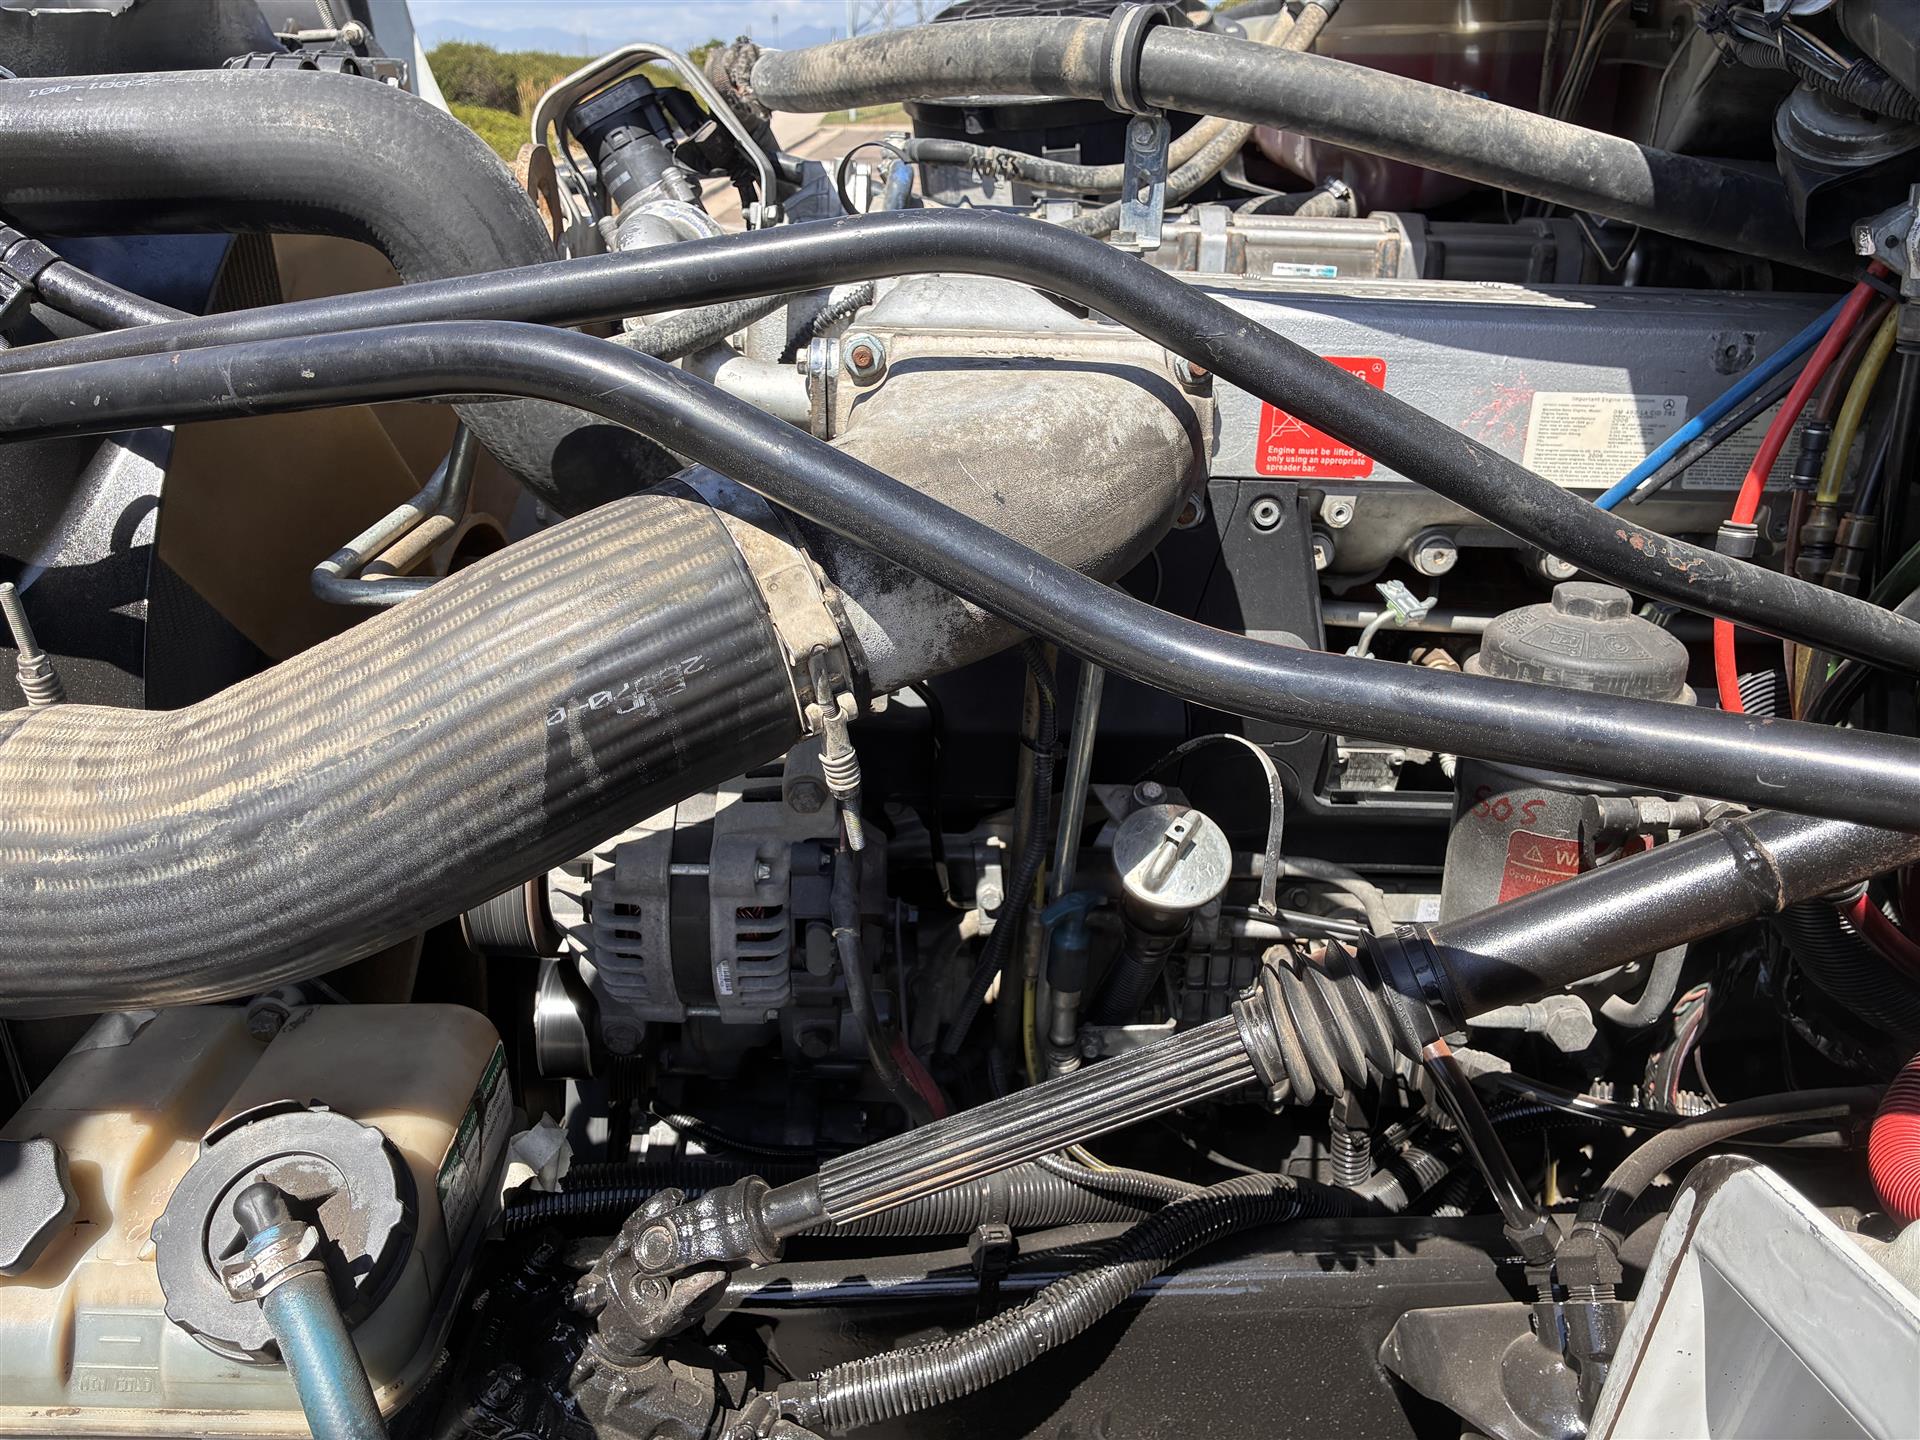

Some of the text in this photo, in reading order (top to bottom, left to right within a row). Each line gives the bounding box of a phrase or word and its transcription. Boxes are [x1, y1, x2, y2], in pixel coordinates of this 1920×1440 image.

[1267, 445, 1296, 456] Engine
[1298, 447, 1318, 455] must
[1321, 447, 1330, 455] be
[1333, 448, 1354, 456] lifted
[1267, 455, 1284, 463] only
[1286, 456, 1309, 465] using
[1320, 456, 1366, 467] appropriate
[1266, 463, 1317, 472] spreader bar.
[1508, 869, 1532, 882] Open
